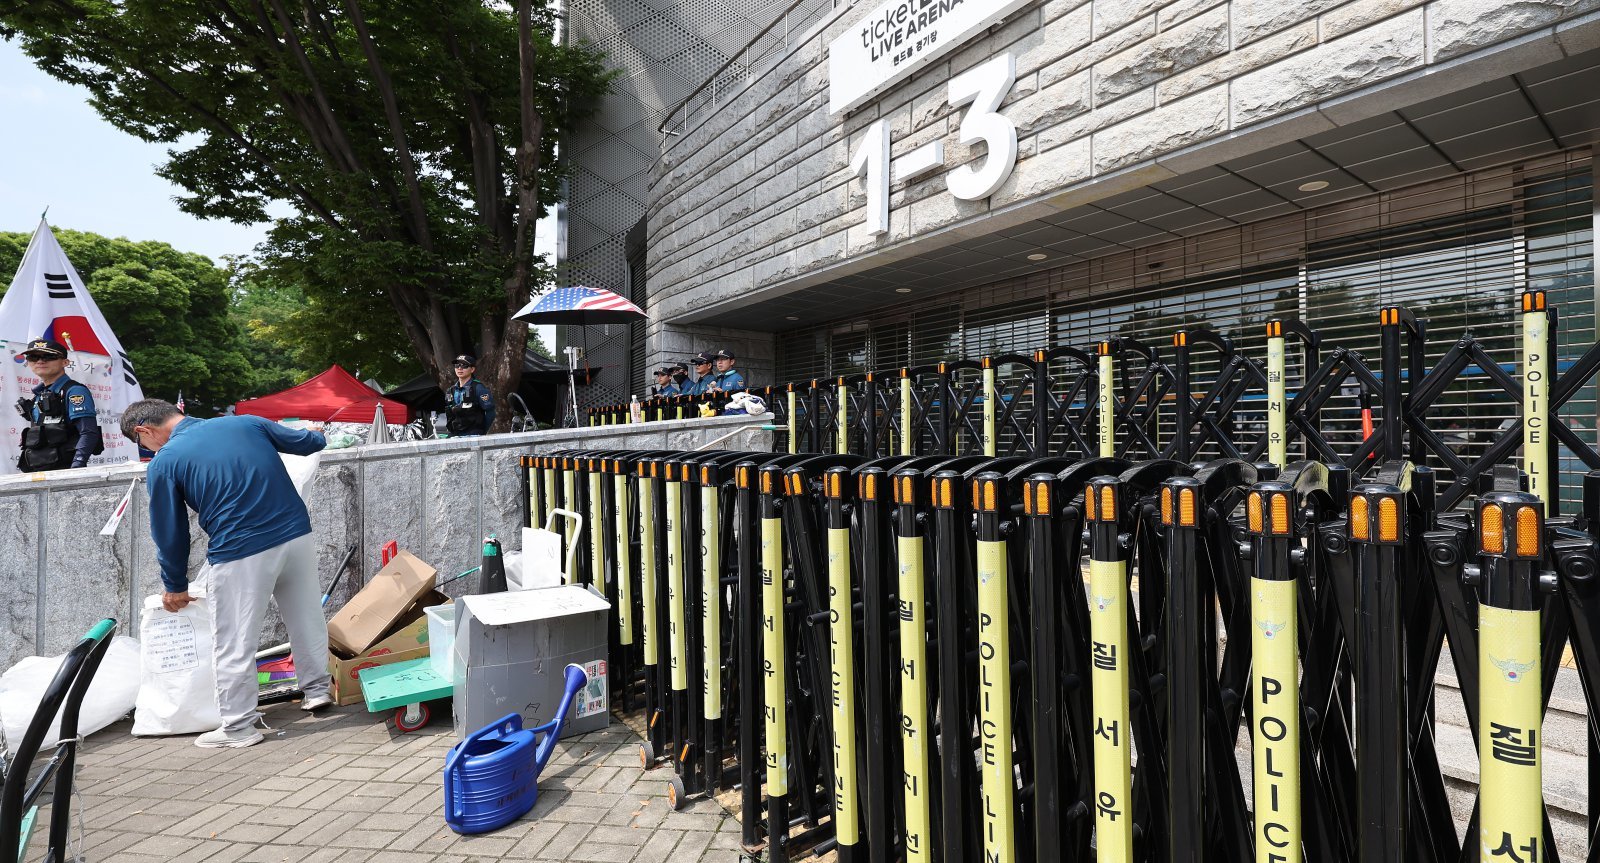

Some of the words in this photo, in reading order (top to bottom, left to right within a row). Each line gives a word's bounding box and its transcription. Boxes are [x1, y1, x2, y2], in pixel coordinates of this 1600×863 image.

[871, 27, 903, 62] LIVE
[850, 51, 1017, 236] 1-3
[1100, 383, 1108, 444] POLICE
[1527, 353, 1542, 444] POLICE
[1530, 461, 1539, 500] LI
[829, 585, 841, 707] POLICE
[979, 612, 996, 766] POLICE
[834, 729, 844, 812] LINE
[899, 600, 919, 854] 질서유지선
[1092, 640, 1122, 822] 질서유
